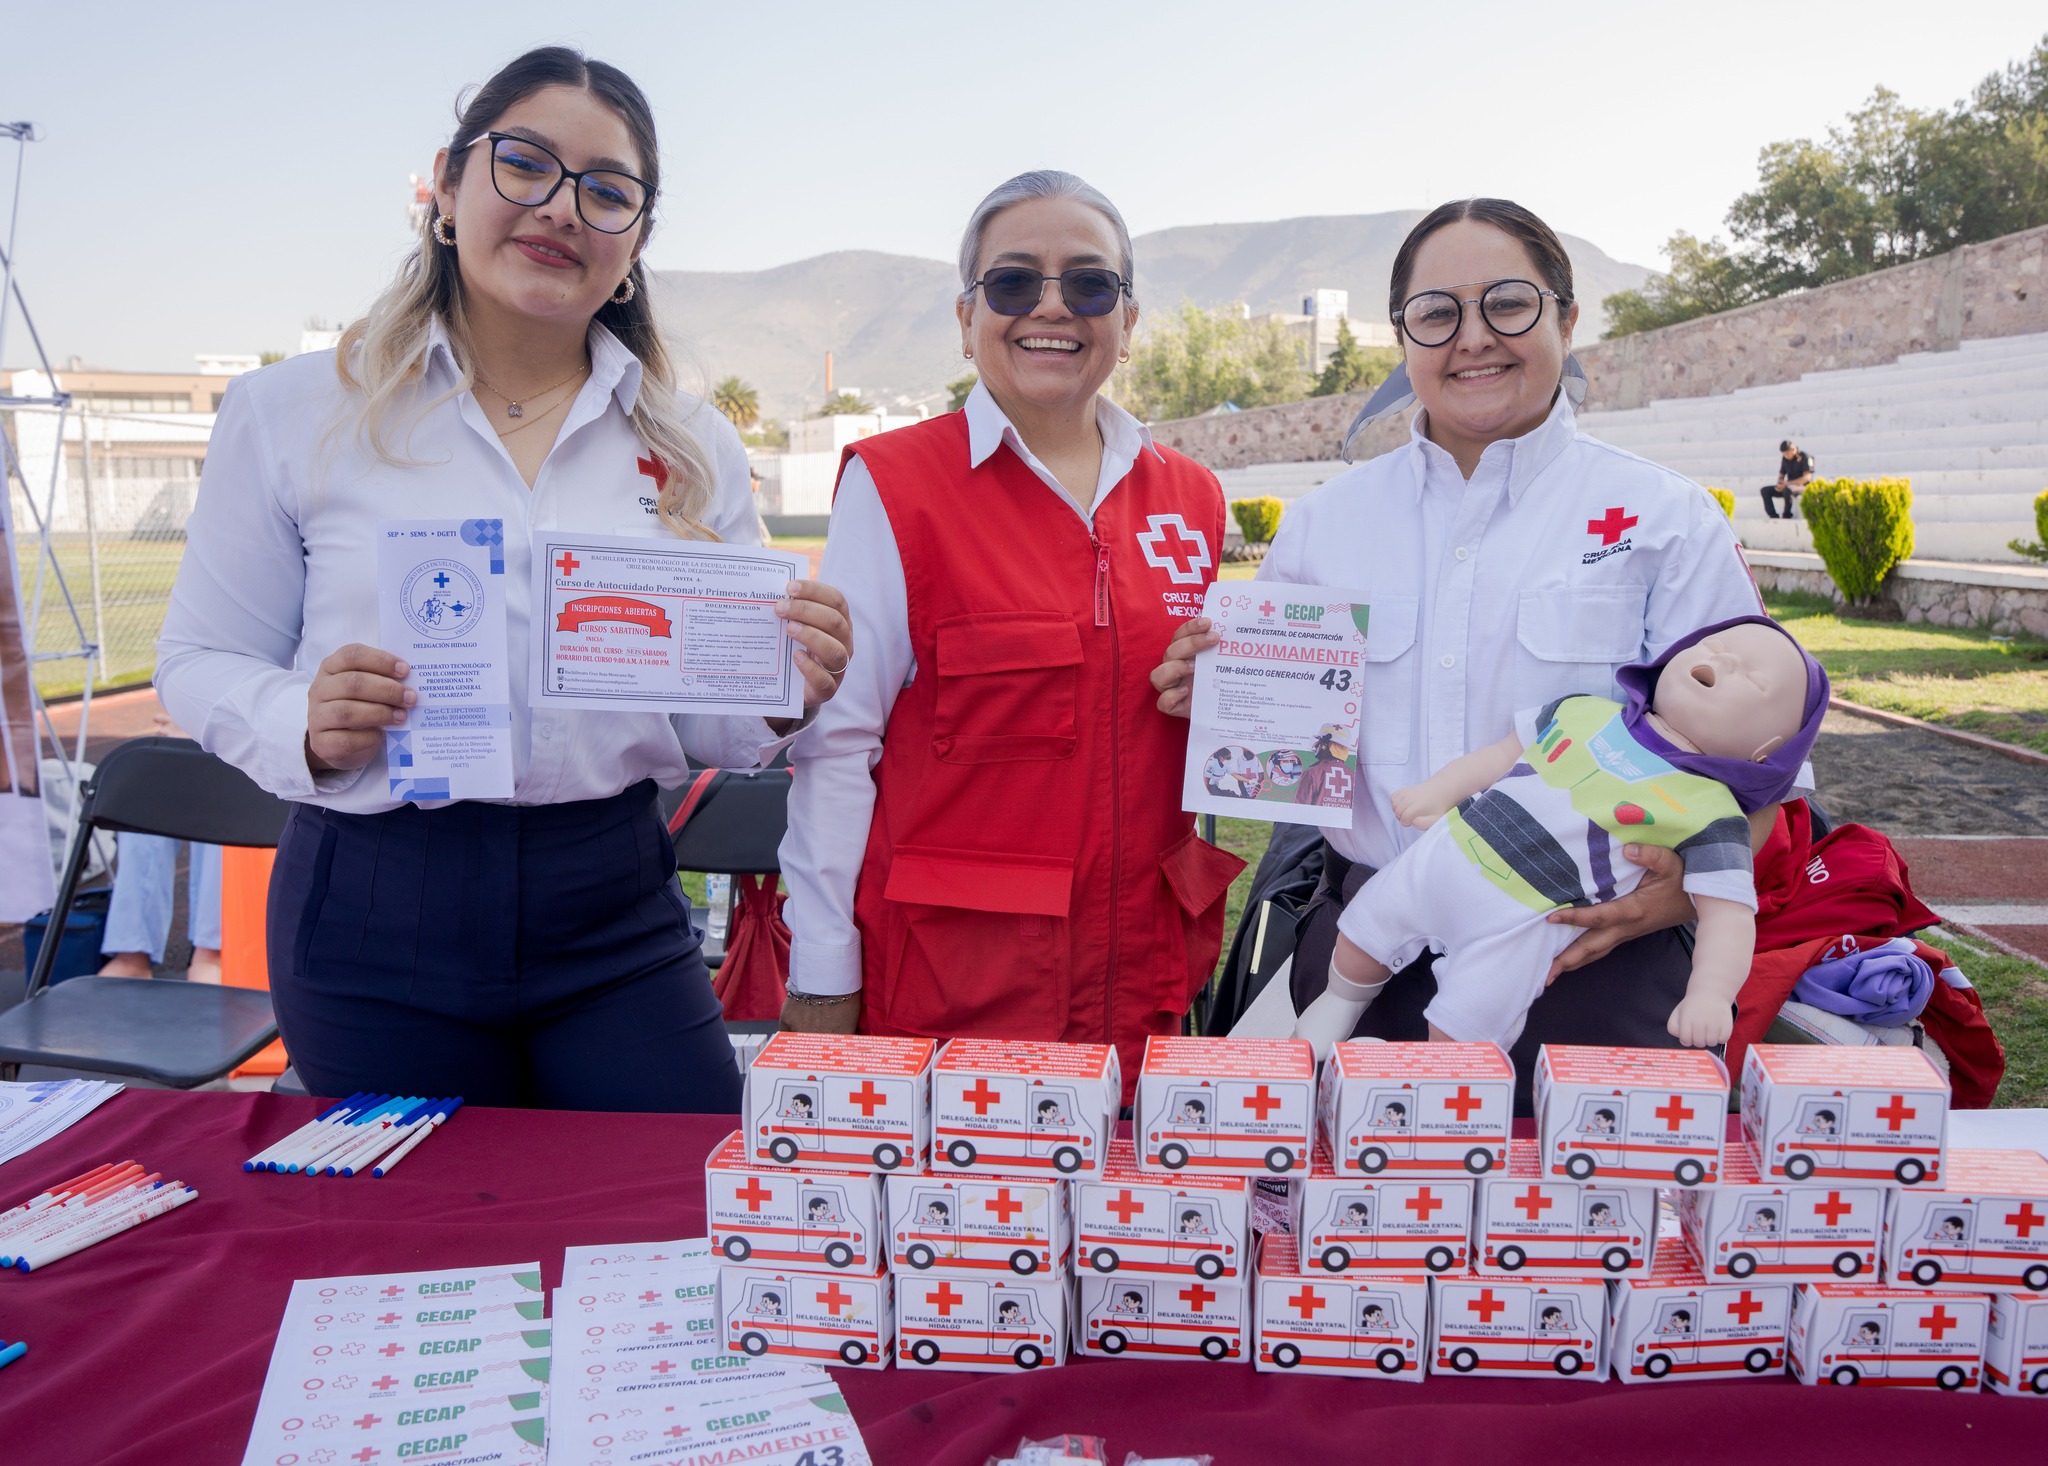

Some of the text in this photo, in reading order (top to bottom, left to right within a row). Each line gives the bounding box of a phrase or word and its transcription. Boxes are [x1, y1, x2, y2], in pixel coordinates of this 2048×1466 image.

[1583, 549, 1608, 558] CRUZ
[555, 578, 581, 587] Curso
[584, 580, 595, 588] de
[597, 581, 654, 591] Autocuidado
[657, 585, 696, 594] Personal
[706, 588, 747, 598] Primeros
[749, 591, 785, 600] Auxilios
[1163, 592, 1204, 605] CRUZ RO
[572, 604, 656, 616] INSCRIPCIONES ABIERTAS
[705, 603, 760, 611] DOCUMENTACIÓN
[1166, 606, 1203, 618] MEXIC
[1284, 604, 1324, 621] CECAP
[580, 625, 649, 635] CURSOS SABATINOS
[1262, 629, 1287, 637] ESTATAL
[1298, 632, 1343, 641] CAPACITACIÓN
[642, 647, 667, 657] SÁBADOS
[1219, 640, 1359, 664] PROXIMAMENTE
[1216, 665, 1352, 691] TUM-BÁSICO GENERACIÓN 43
[1806, 855, 1829, 885] NO
[941, 1115, 988, 1123] DELEGACIÓN
[1084, 1223, 1131, 1231] DELEGACIÓN
[418, 1280, 476, 1295] CECAP
[416, 1309, 477, 1322] CECAP
[796, 1314, 873, 1325] DELEGACIÓN ESTATAL
[419, 1338, 482, 1355] CECAP
[656, 1340, 694, 1349] ESTATAL
[414, 1369, 479, 1388] CECAP
[617, 1384, 656, 1392] CENTRO
[658, 1380, 698, 1388] ESTATAL
[713, 1371, 786, 1382] CAPACITACIÓN
[397, 1405, 465, 1426] CECAP
[706, 1410, 771, 1431] CECAP
[397, 1434, 468, 1457] CECAP
[630, 1449, 673, 1461] CENTRO
[675, 1440, 717, 1452] ESTATAL
[736, 1421, 811, 1440] CAPACITACIÓN
